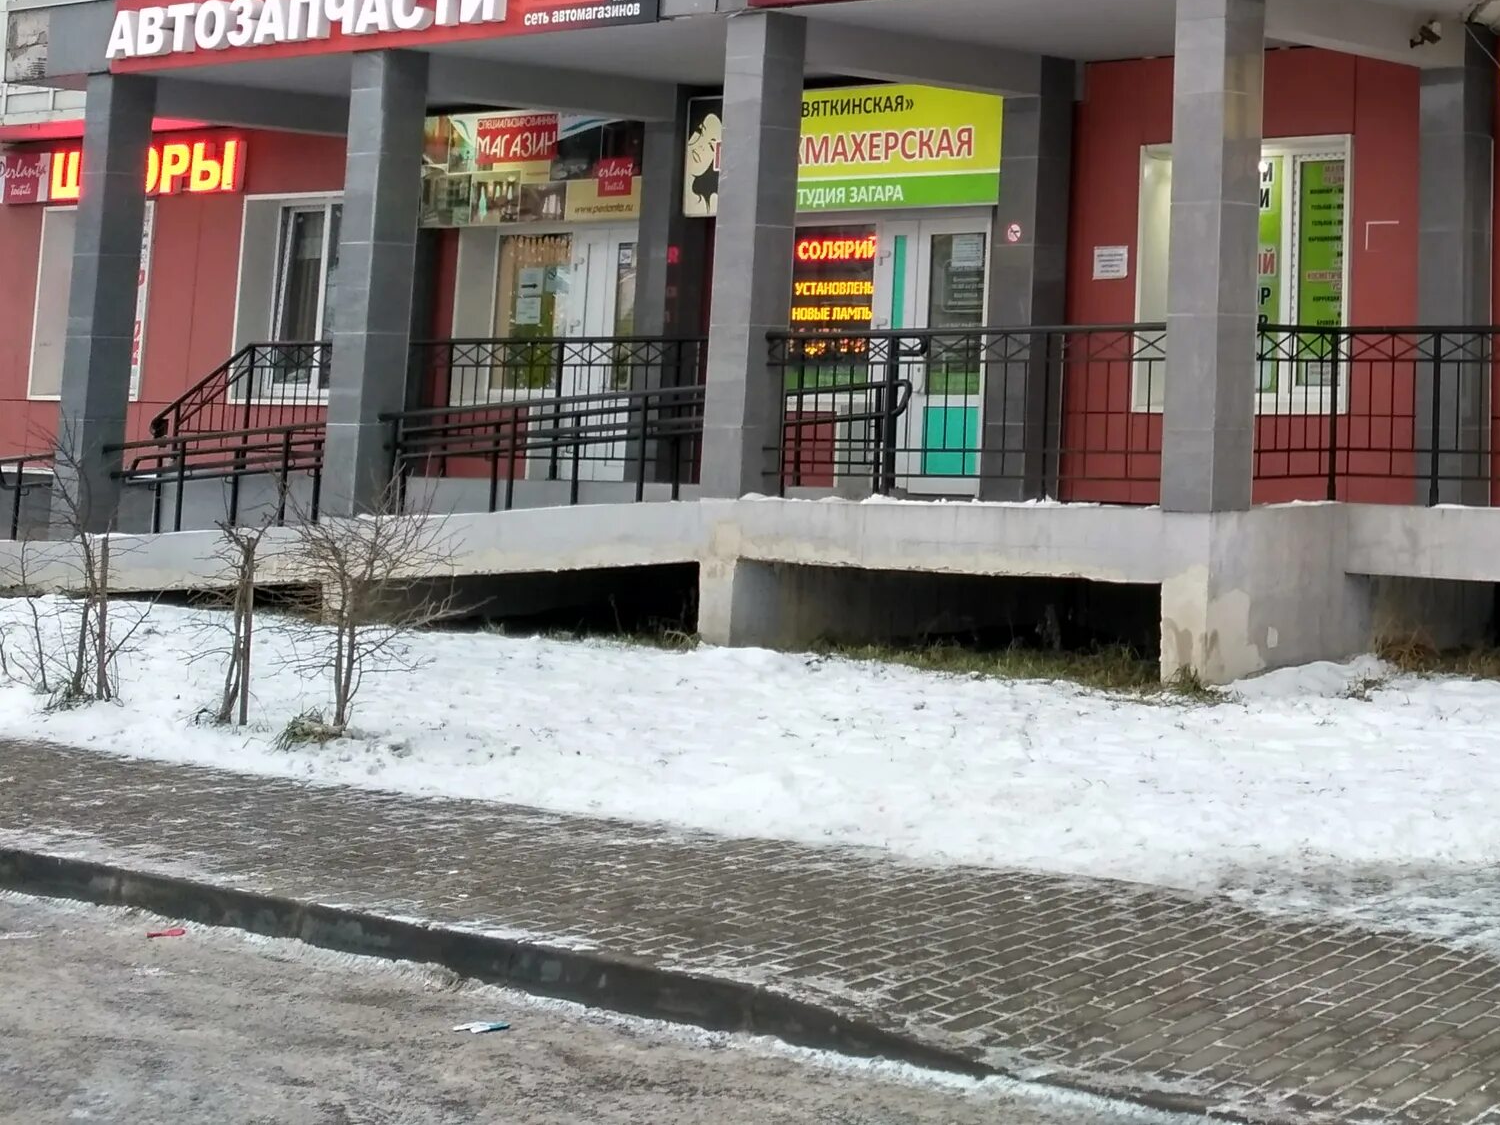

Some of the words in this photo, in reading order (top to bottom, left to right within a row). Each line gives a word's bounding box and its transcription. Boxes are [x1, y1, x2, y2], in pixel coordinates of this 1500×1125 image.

[524, 11, 549, 26] сеть
[551, 2, 641, 23] автомагазинов
[800, 94, 915, 119] ВЯТКИНСКАЯ»
[476, 131, 557, 159] МАГАЗИН
[797, 126, 975, 167] МАХЕРСКАЯ
[50, 139, 238, 201] ШОРЫ
[797, 187, 846, 206] ТУДИЯ
[849, 184, 904, 204] ЗАГАРА
[791, 307, 830, 321] НОВЫЕ
